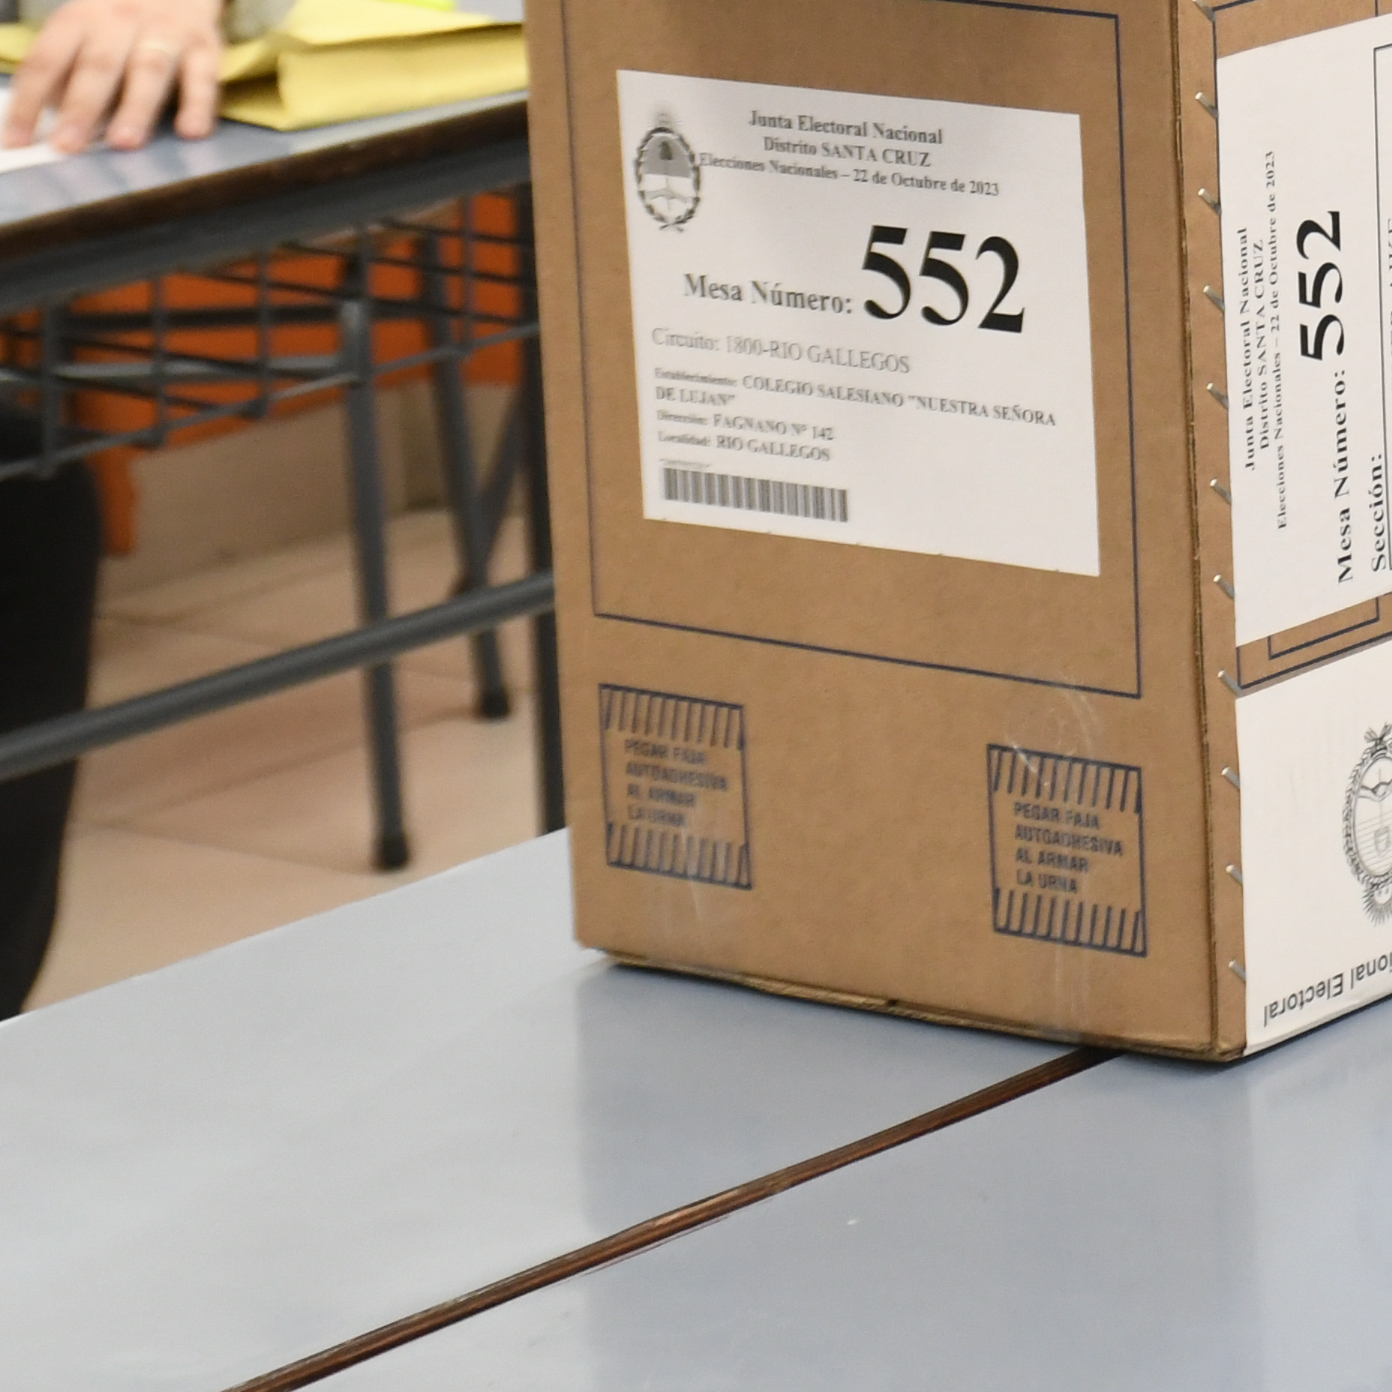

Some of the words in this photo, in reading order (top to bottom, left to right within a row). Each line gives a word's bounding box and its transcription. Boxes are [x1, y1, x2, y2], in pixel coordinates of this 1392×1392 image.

[748, 110, 793, 130] Junta
[797, 114, 868, 138] Electoral
[872, 122, 943, 145] Nacional
[763, 136, 817, 156] Distrito
[821, 143, 877, 163] SANTA
[882, 148, 931, 168] CRUZ
[700, 152, 765, 173] Elecciones
[769, 160, 838, 180] Nacionales
[853, 168, 868, 183] 22
[872, 170, 888, 186] de
[891, 172, 947, 191] Octubre
[950, 178, 966, 193] de
[969, 181, 999, 197] 2023
[1265, 151, 1275, 189] 2023
[1266, 193, 1276, 213] de
[1237, 227, 1250, 315] Nacional
[1253, 239, 1265, 300] CRUZ
[1268, 217, 1279, 286] Octubre
[682, 272, 743, 303] Mesa
[750, 279, 853, 316] Número:
[862, 224, 1026, 333] 552
[1270, 290, 1279, 309] de
[1296, 210, 1345, 361] 552
[1255, 305, 1267, 377] SANTA
[1270, 314, 1280, 333] 22
[651, 327, 720, 353] Circuito:
[726, 336, 802, 361] 1800-RIO
[806, 344, 911, 374] GALLEGOS
[1239, 320, 1253, 410] Electoral
[656, 386, 676, 403] DE
[742, 374, 814, 397] COLEGIO
[817, 383, 904, 408] SALESIANO
[908, 394, 989, 419] "NUESTRA
[992, 402, 1057, 427] SEÑORA
[1258, 381, 1270, 450] Distrito
[1272, 352, 1284, 441] Nacionales
[713, 414, 787, 436] FAGNANO
[811, 425, 835, 441] 142
[716, 435, 743, 452] RIO
[747, 438, 831, 462] GALLEGOS
[1244, 416, 1256, 471] Junta
[1333, 369, 1350, 499] Número:
[1276, 444, 1287, 529] Elecciones
[1368, 453, 1387, 572] Sección:
[1337, 506, 1353, 584] Mesa
[1014, 801, 1060, 824] PEGAR
[1066, 809, 1100, 830] FAJA
[1015, 824, 1124, 857] AUTOADHESIVA
[1016, 847, 1033, 864] AL
[1038, 849, 1090, 874] ARMAR
[1016, 870, 1033, 887] LA
[1038, 873, 1078, 894] URNA
[1263, 972, 1344, 1028] Electoral
